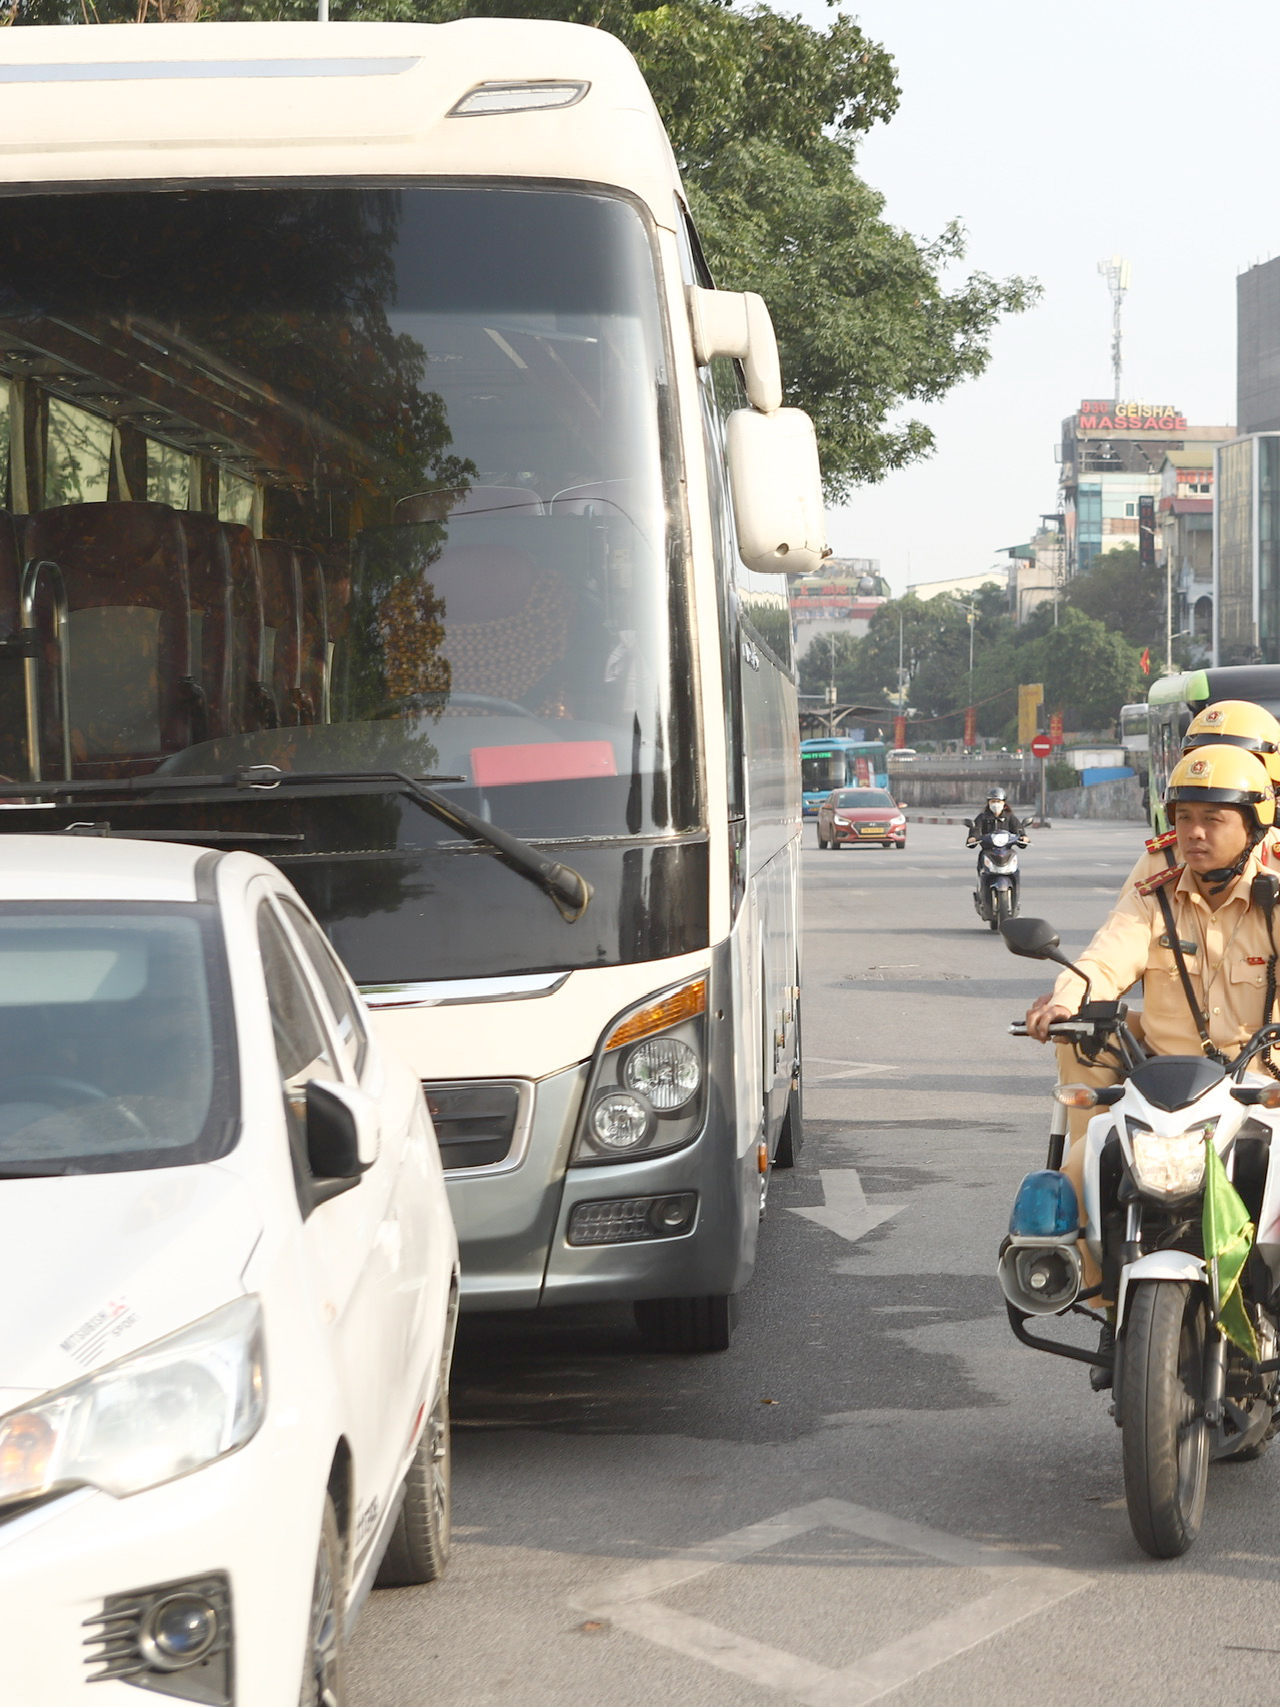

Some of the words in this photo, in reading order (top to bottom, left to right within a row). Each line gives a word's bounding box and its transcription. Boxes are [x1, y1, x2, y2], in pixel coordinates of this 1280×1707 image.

[1082, 401, 1109, 414] 930
[1115, 404, 1175, 418] GEISHA
[1080, 416, 1188, 430] MASSAGE
